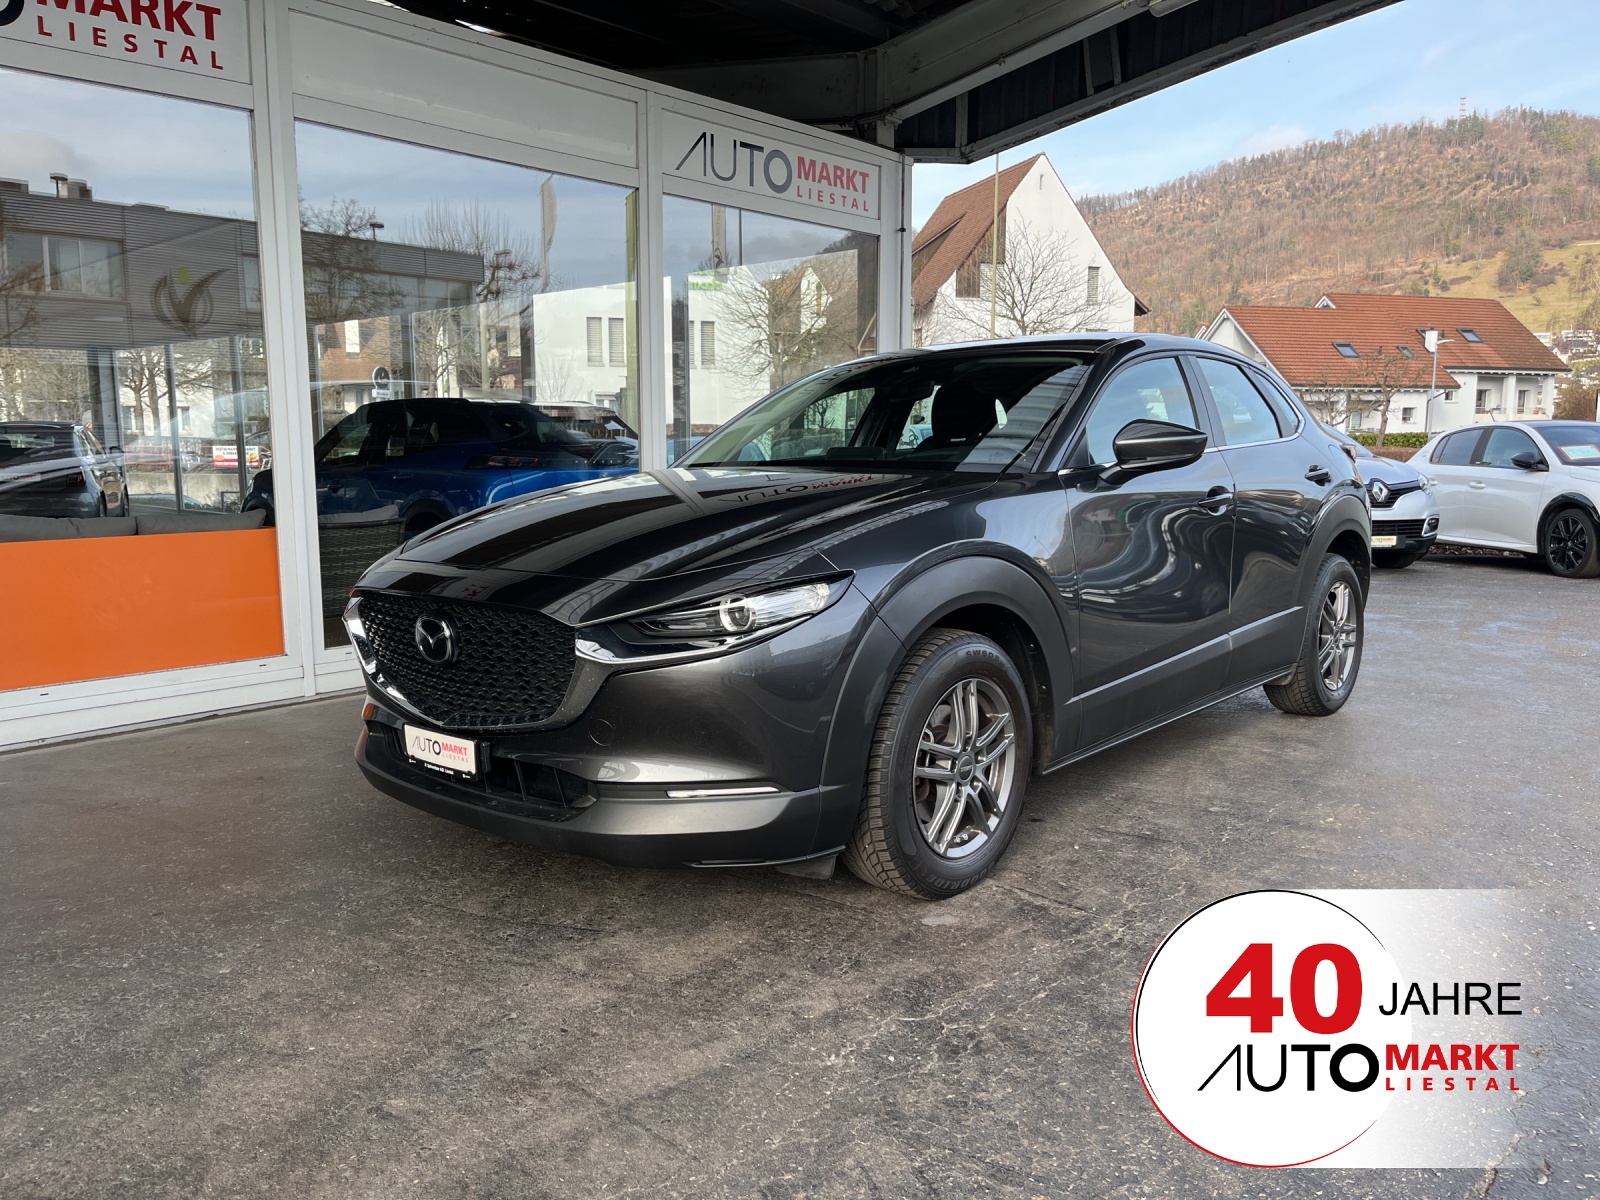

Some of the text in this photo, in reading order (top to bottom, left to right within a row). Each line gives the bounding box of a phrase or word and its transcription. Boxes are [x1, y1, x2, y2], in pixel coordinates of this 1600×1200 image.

[37, 0, 221, 40] ARKT
[37, 16, 223, 70] LIESTAL
[675, 131, 869, 194] AUTO MARKT
[797, 185, 869, 212] LIESTAL
[412, 735, 467, 756] AUTO MARKT
[442, 753, 469, 763] LIESTAL
